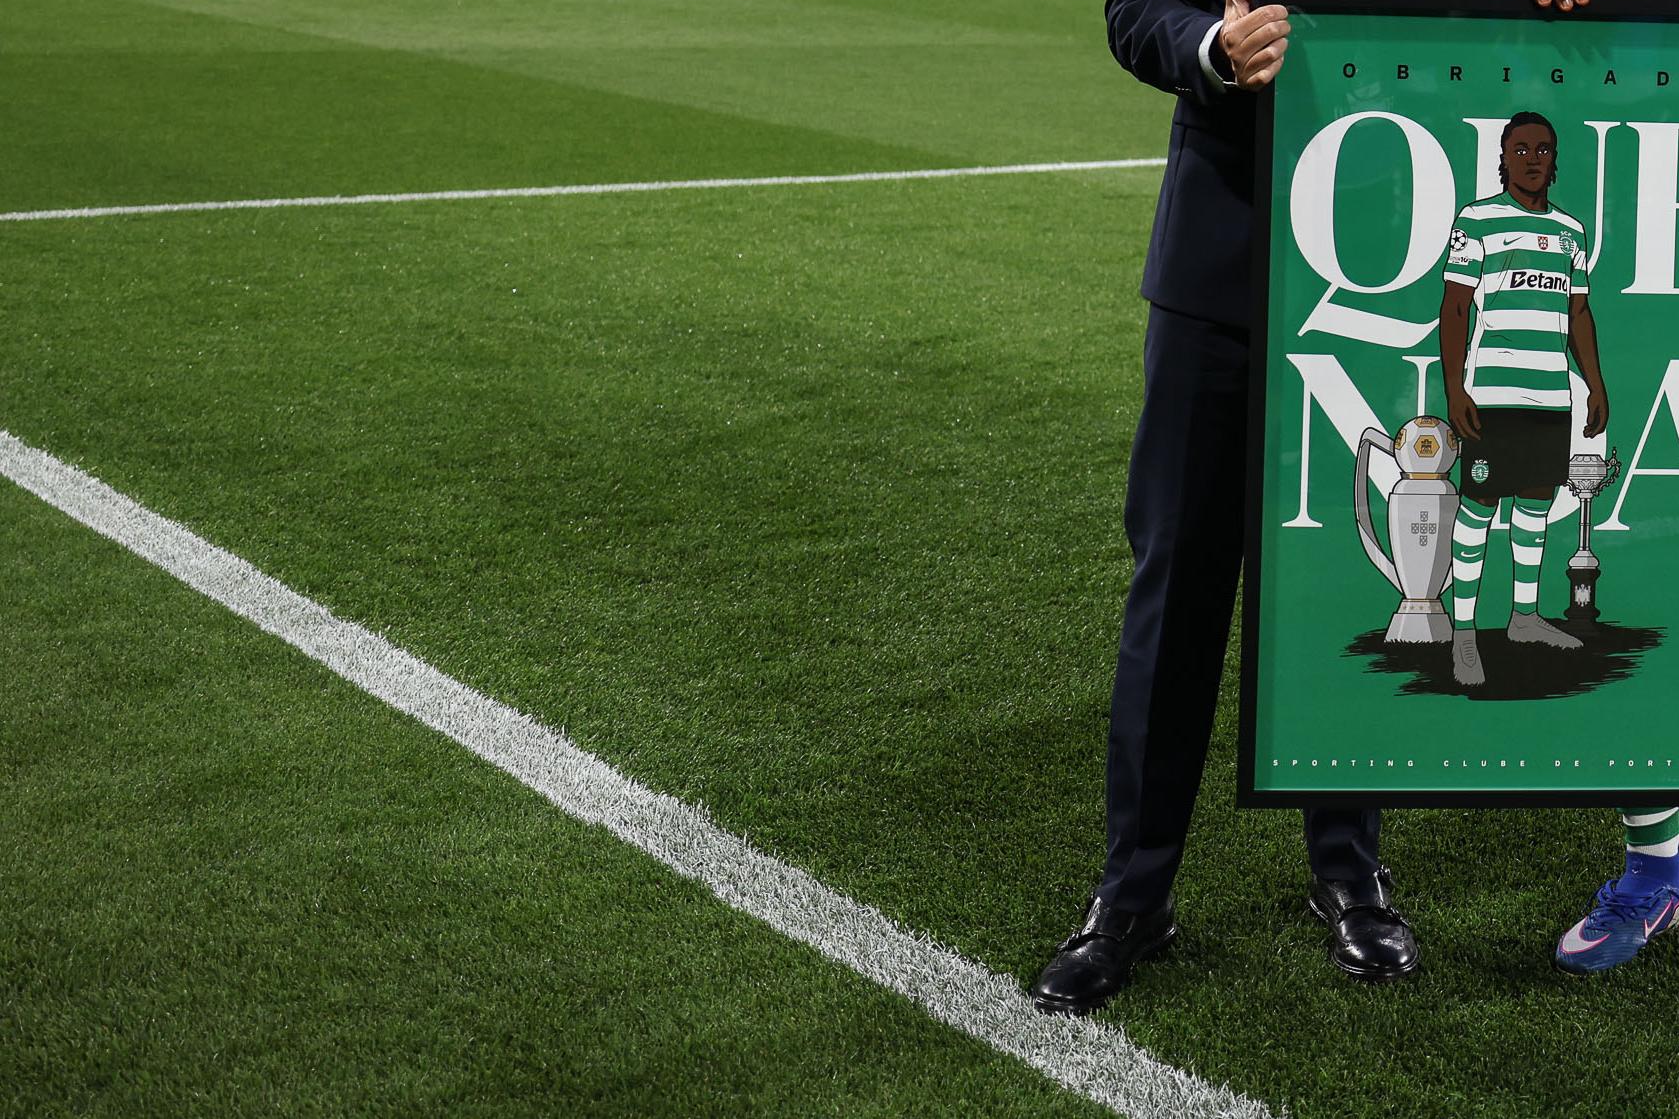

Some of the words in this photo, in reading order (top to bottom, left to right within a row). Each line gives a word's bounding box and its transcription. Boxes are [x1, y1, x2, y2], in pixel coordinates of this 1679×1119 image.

[1273, 759, 1413, 767] SPORTING
[1443, 759, 1525, 767] CLUBE
[1554, 759, 1580, 767] DE
